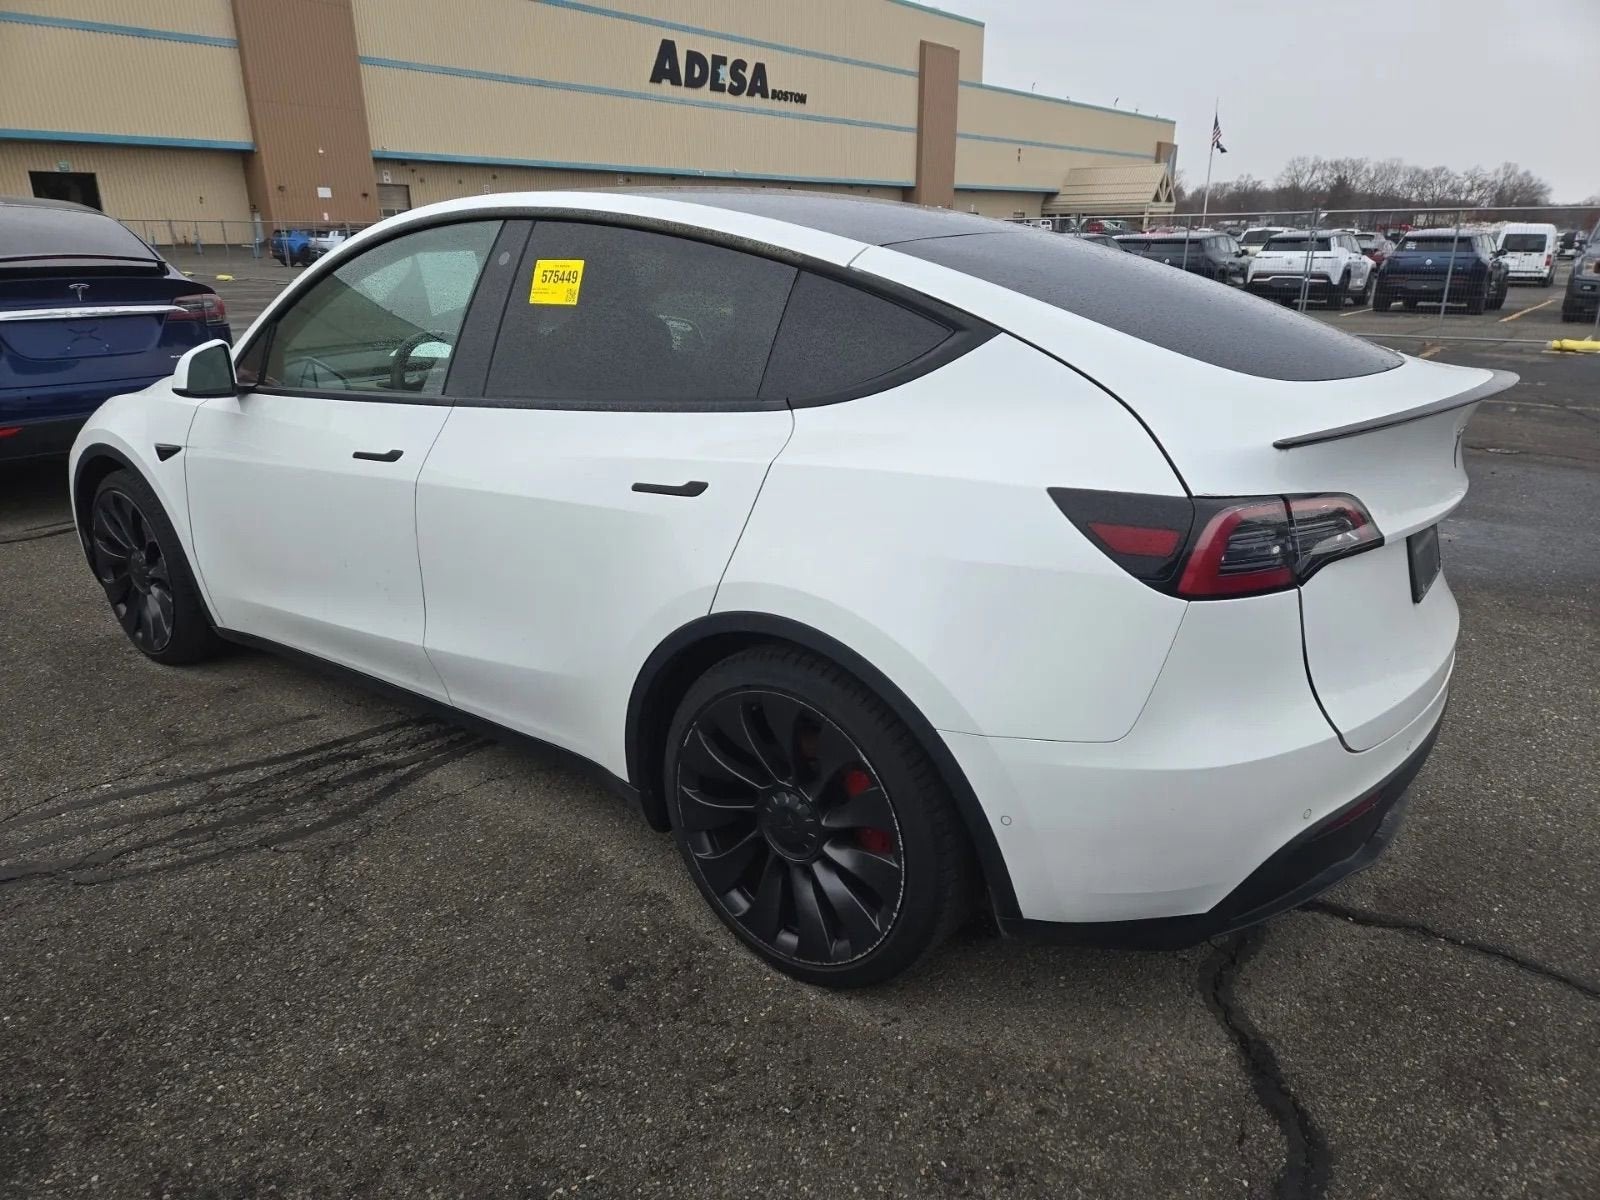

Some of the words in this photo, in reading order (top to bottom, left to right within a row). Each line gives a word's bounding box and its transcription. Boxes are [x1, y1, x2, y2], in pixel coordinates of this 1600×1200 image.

[649, 39, 769, 99] ADESA
[771, 89, 807, 104] BOSTON
[541, 270, 578, 284] 575449
